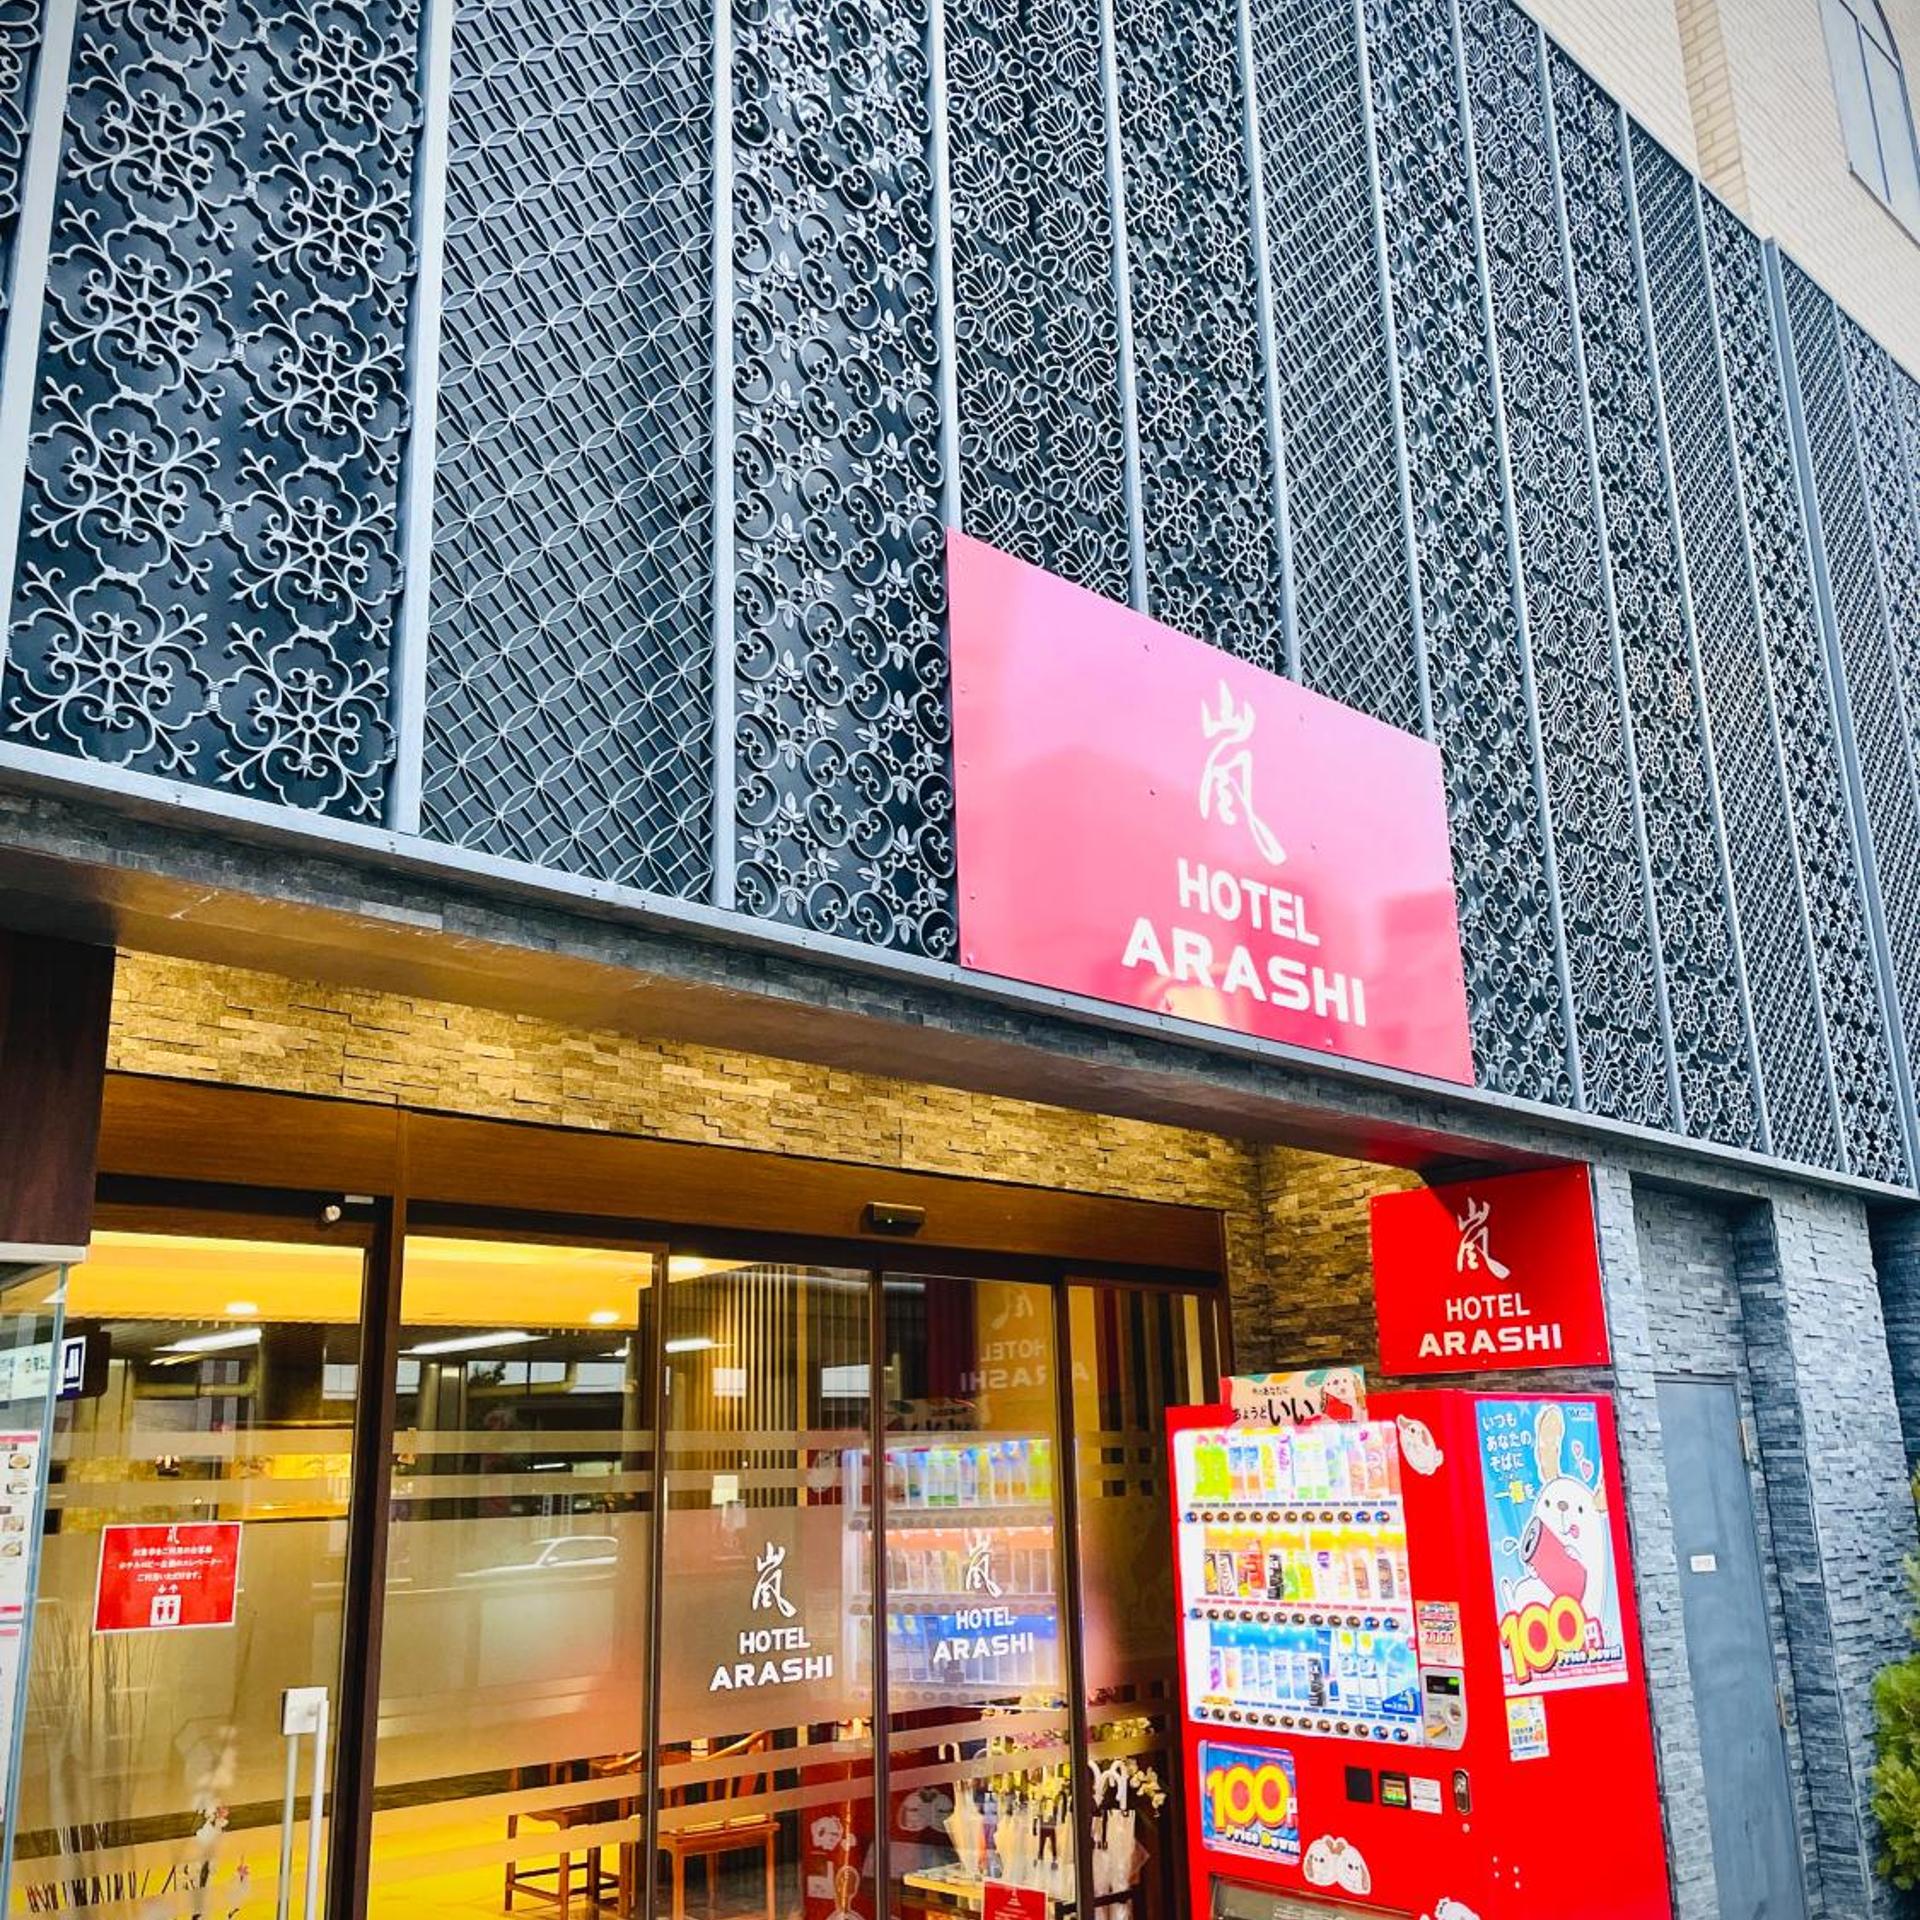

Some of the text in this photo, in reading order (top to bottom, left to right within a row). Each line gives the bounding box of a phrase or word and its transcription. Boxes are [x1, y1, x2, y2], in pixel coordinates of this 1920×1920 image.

[1199, 679, 1286, 866] 嵐
[1177, 857, 1320, 947] HOTEL
[1121, 917, 1367, 1027] ARASHI
[1456, 1197, 1511, 1280] 嵐
[1445, 1292, 1531, 1322] HOTEL
[1418, 1323, 1563, 1358] ARASHI
[1482, 1412, 1517, 1431] いつも
[1485, 1429, 1532, 1452] あなたの
[1489, 1451, 1526, 1473] そばに
[752, 1541, 797, 1618] 嵐
[964, 1530, 1002, 1599] 嵐
[955, 1606, 1017, 1630] HOTEL
[739, 1627, 811, 1655] HOTEL
[933, 1632, 1034, 1663] ARASHI
[709, 1655, 834, 1692] ARASHI
[1225, 1824, 1260, 1847] Price
